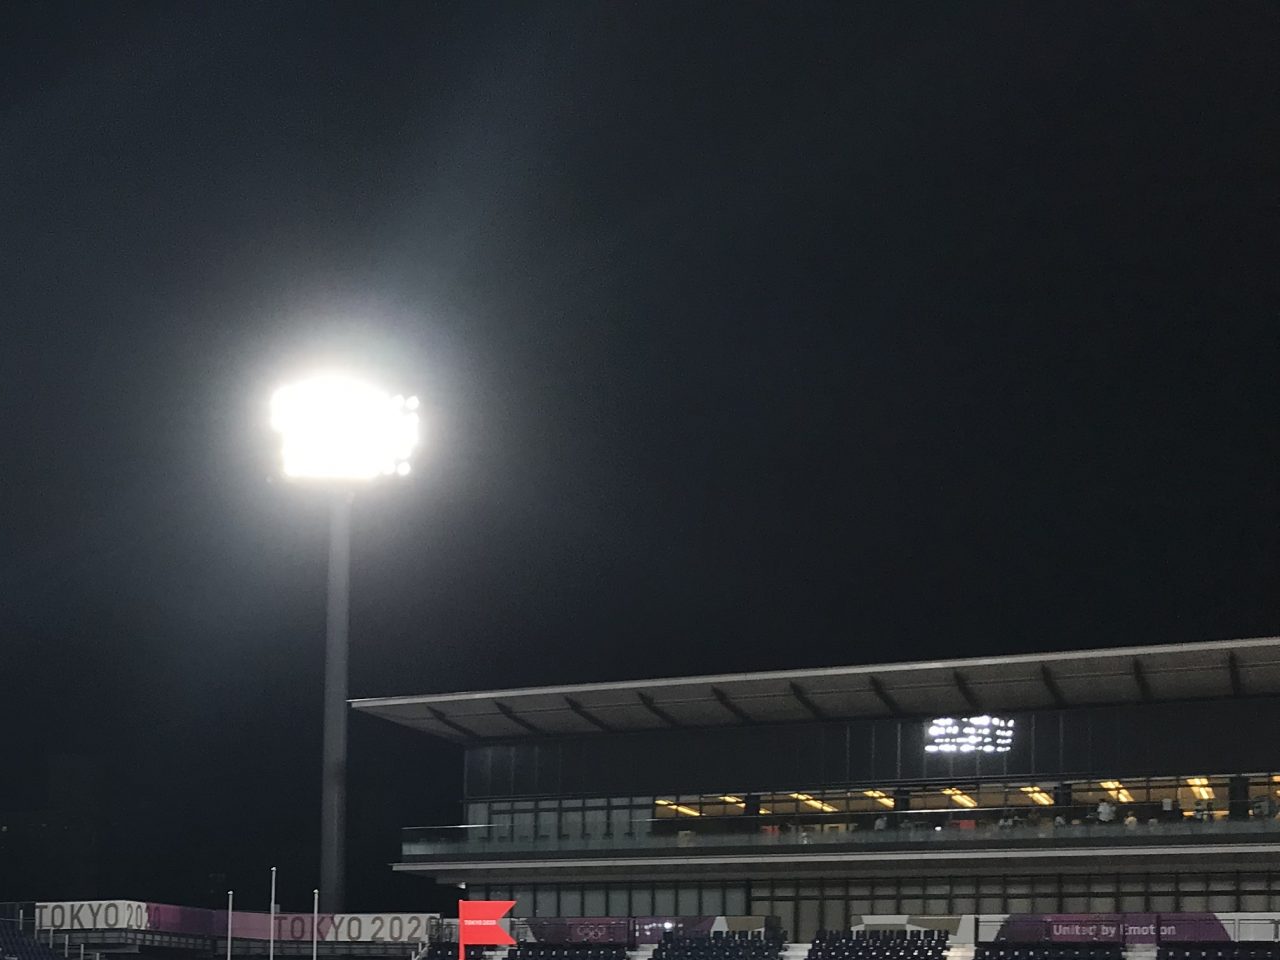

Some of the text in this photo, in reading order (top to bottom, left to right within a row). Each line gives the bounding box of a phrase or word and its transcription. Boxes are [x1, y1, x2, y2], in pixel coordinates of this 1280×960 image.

[35, 902, 119, 929] TOKYO
[274, 916, 362, 941] TOKYO
[1053, 924, 1097, 936] United
[1101, 924, 1116, 938] by
